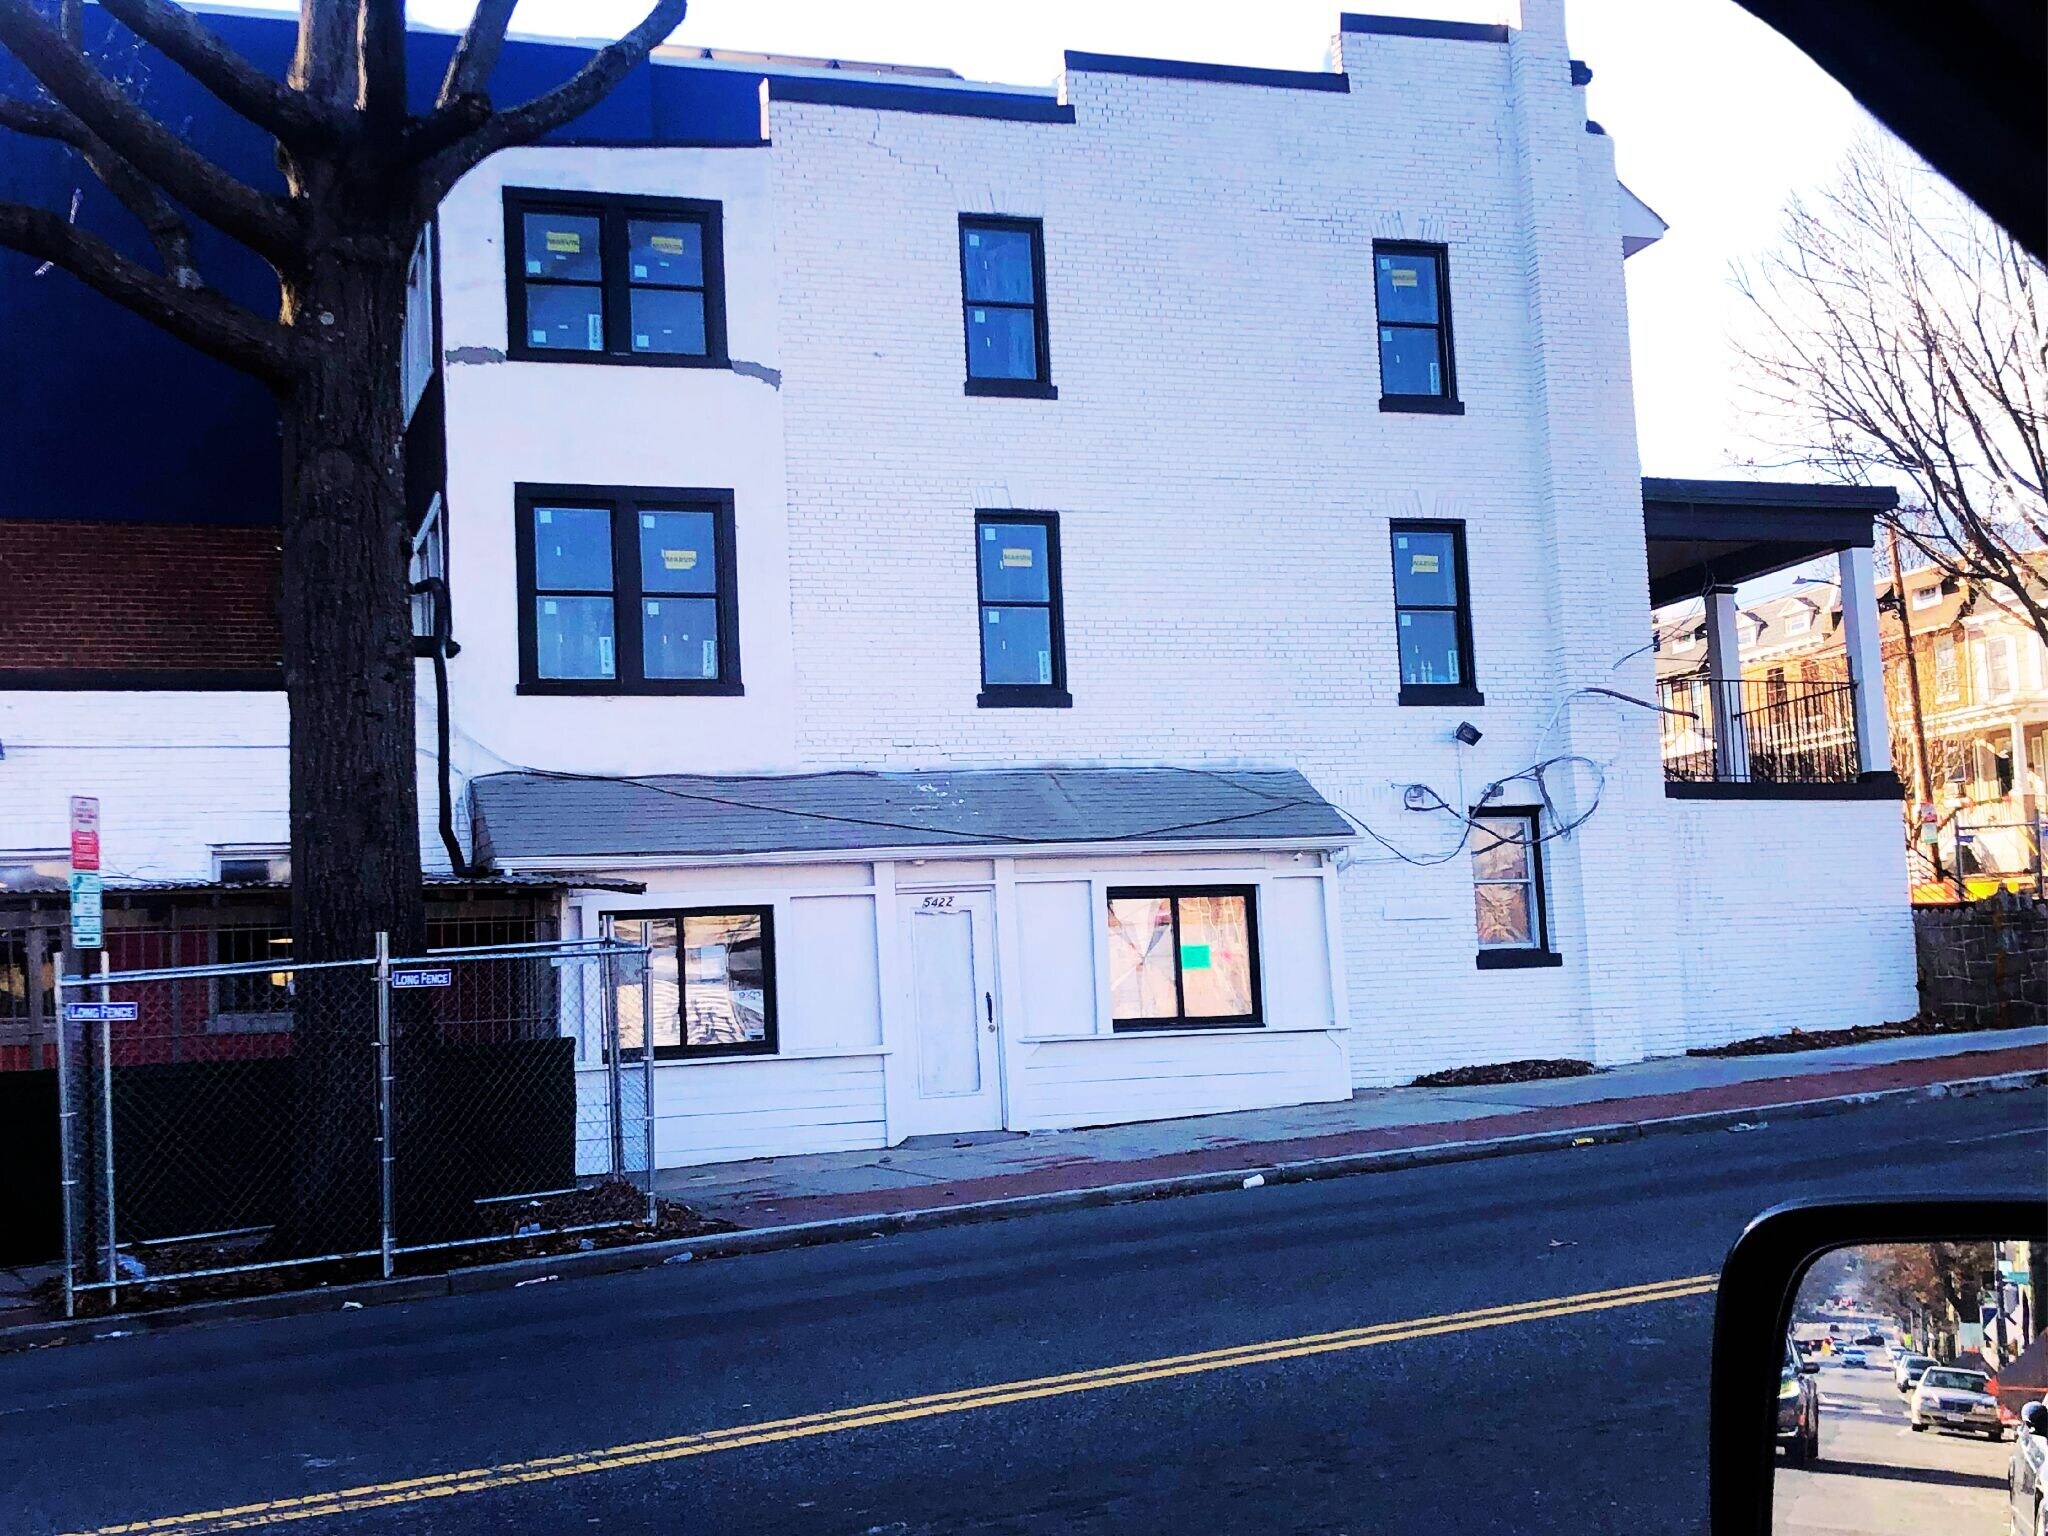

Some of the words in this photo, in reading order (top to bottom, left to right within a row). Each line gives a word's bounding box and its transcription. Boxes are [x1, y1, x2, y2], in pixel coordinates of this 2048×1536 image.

[922, 895, 955, 909] 5422
[395, 973, 420, 985] LONG
[420, 972, 448, 984] FENCE
[71, 1006, 100, 1018] LONG
[100, 1005, 135, 1018] FENCE
